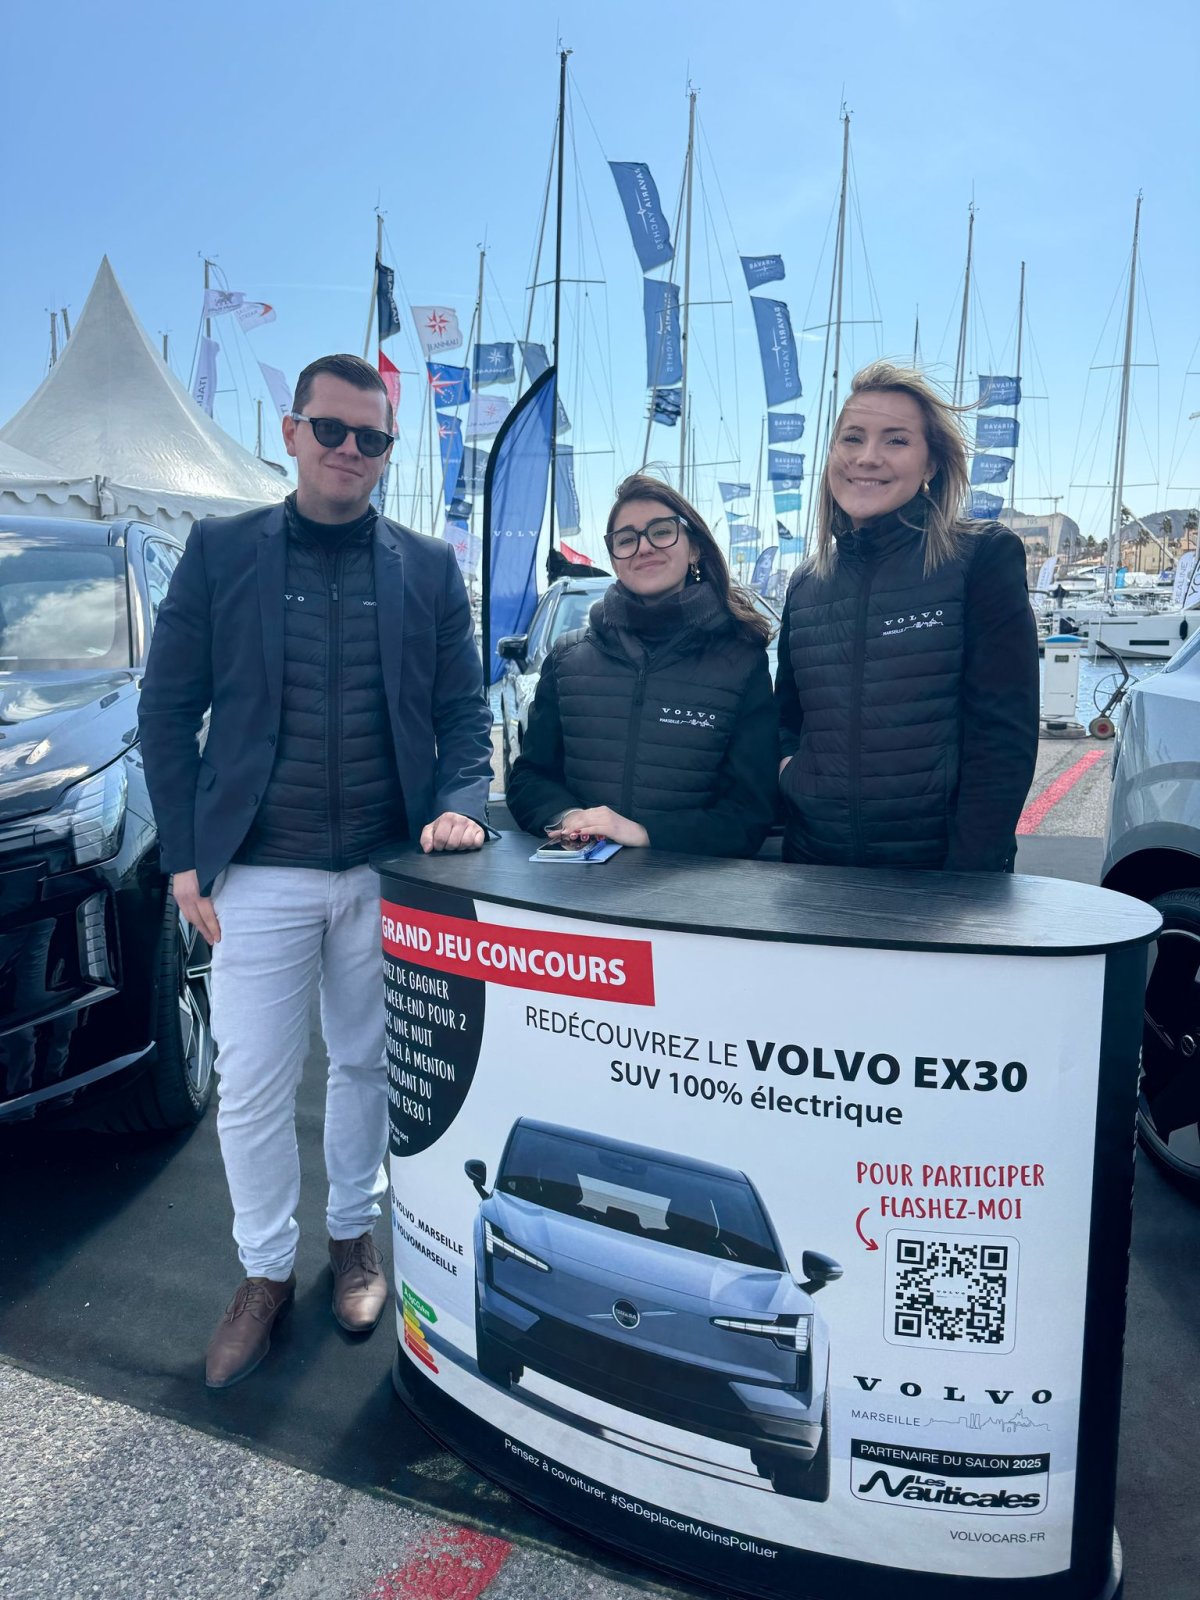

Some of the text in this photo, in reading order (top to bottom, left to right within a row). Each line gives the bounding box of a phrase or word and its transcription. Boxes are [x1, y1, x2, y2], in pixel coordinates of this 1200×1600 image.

[884, 609, 943, 626] VOLVO
[661, 707, 716, 720] VOLVO
[382, 916, 627, 986] GRAND JEU CONCOURS
[396, 966, 407, 986] DE
[409, 971, 449, 1000] GAGNER
[394, 1015, 409, 1038] UNE
[411, 1024, 432, 1047] NUIT
[428, 1003, 456, 1029] POUR
[460, 1013, 467, 1031] 2
[405, 1043, 411, 1064] À
[413, 1051, 455, 1082] MENTON
[525, 1005, 1028, 1093] REDÉCOUVREZ LE VOLVO EX30
[390, 1061, 432, 1099] VOLANT DU
[610, 1061, 903, 1128] SUV 100% électrique
[402, 1095, 425, 1121] EX30
[856, 1161, 1045, 1188] POUR PARTICIPER
[880, 1195, 1022, 1220] FLASHEZ-MOI
[396, 1220, 458, 1277] VOLVOMARSEILLE
[853, 1375, 1052, 1404] VOLVO
[851, 1409, 921, 1427] MARSEILLE
[860, 1444, 1042, 1469] PARTENAIRE DU SALON 2025
[858, 1470, 1041, 1509] Nauticales
[915, 1475, 946, 1487] Les
[504, 1438, 778, 1559] Pensez à covoiturer. #SeDeplacerMoinsPolluer
[950, 1530, 1046, 1544] VOLVOCARS.FR
